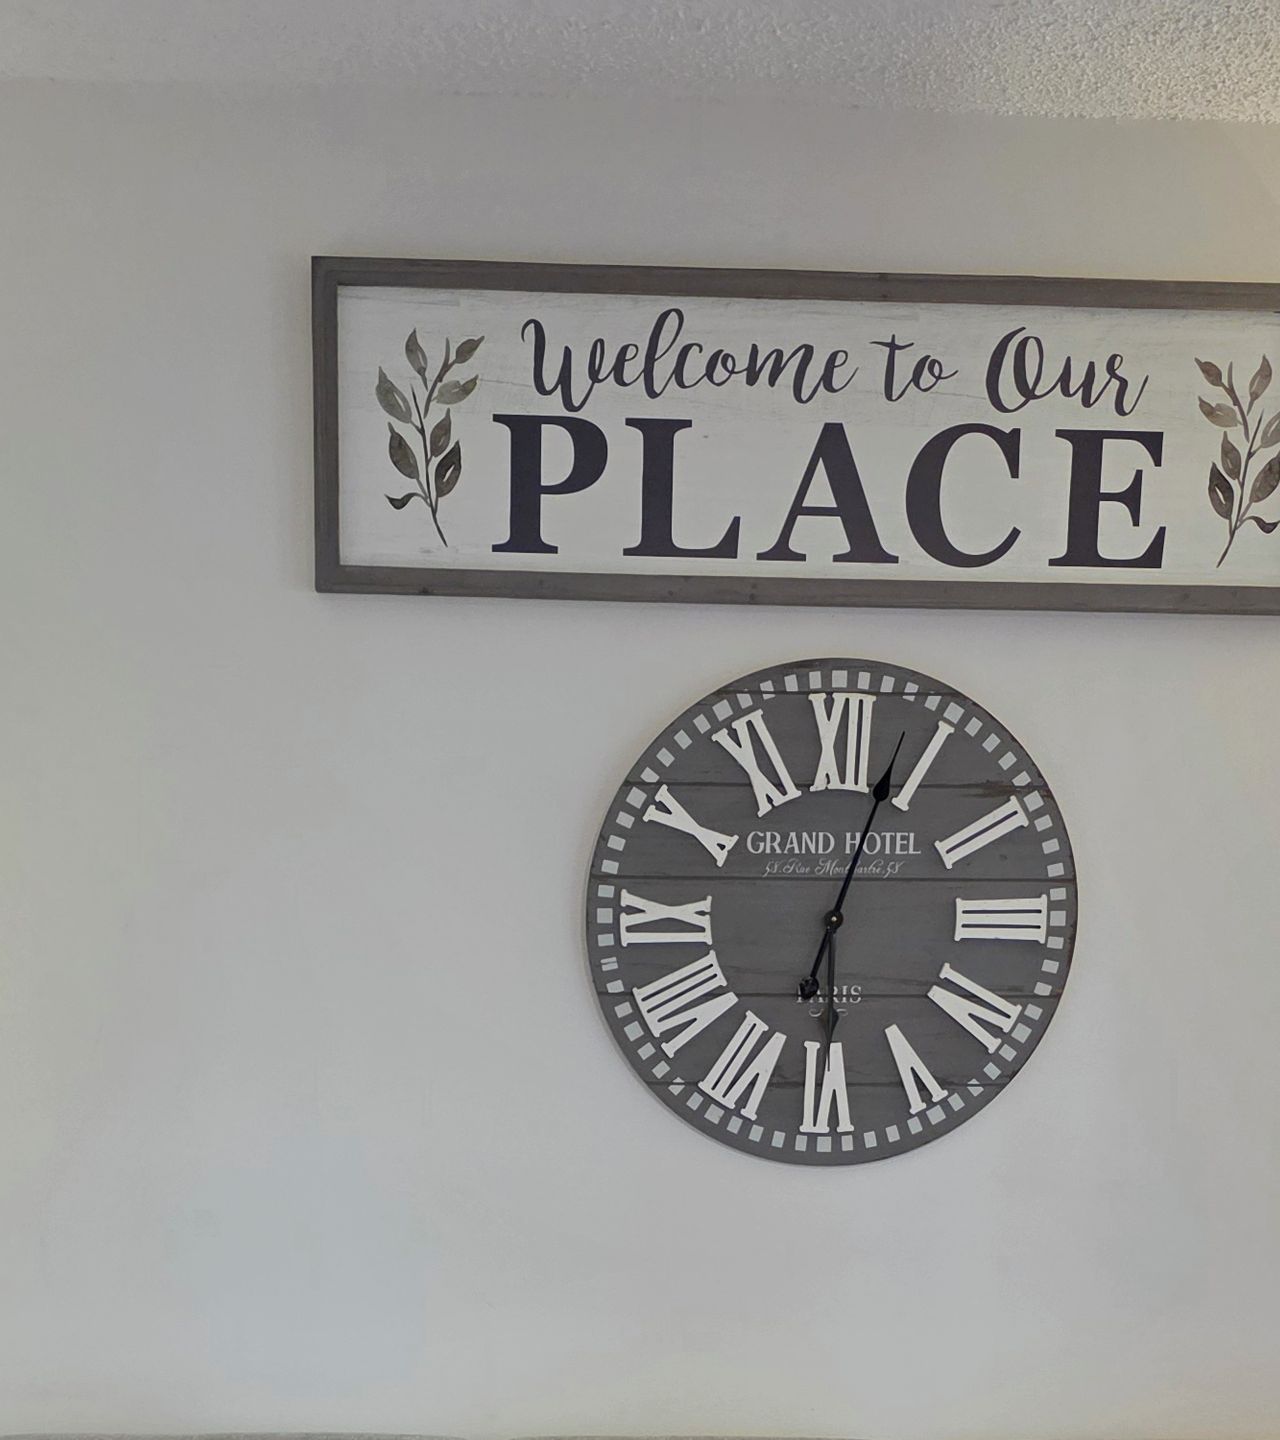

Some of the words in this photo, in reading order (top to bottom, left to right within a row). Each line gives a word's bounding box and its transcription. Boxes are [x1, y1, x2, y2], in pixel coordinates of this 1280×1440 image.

[521, 307, 858, 411] Welcome
[870, 334, 959, 402] to
[985, 326, 1149, 417] Our
[491, 413, 1168, 569] PLACE
[711, 708, 802, 818] XI
[808, 692, 877, 794] XII
[891, 720, 955, 811] I
[642, 783, 740, 868] X
[746, 831, 835, 855] GRAND
[845, 831, 921, 855] HOTEL
[934, 795, 1029, 870] II
[619, 888, 713, 947] IX
[954, 894, 1048, 944] III
[632, 949, 739, 1059] VIII
[927, 962, 1023, 1054] IV
[697, 1010, 787, 1121] VII
[799, 1040, 855, 1134] VI
[884, 1024, 949, 1115] V
